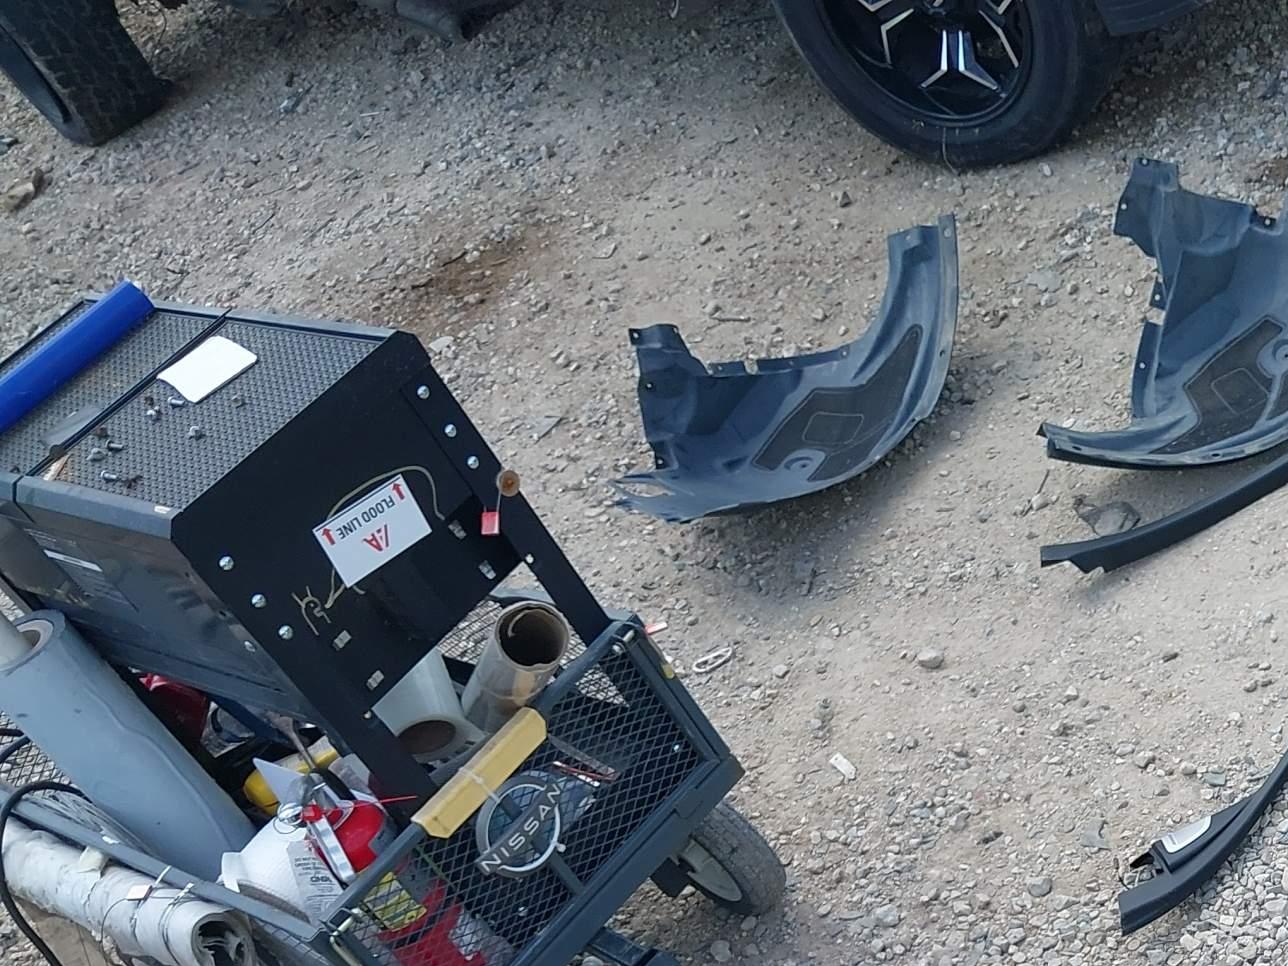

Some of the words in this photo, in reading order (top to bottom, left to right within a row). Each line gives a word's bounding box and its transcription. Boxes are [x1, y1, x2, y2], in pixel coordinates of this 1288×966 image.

[362, 496, 395, 522] FLOOD
[336, 519, 362, 539] LINE
[480, 776, 567, 873] NISSAN
